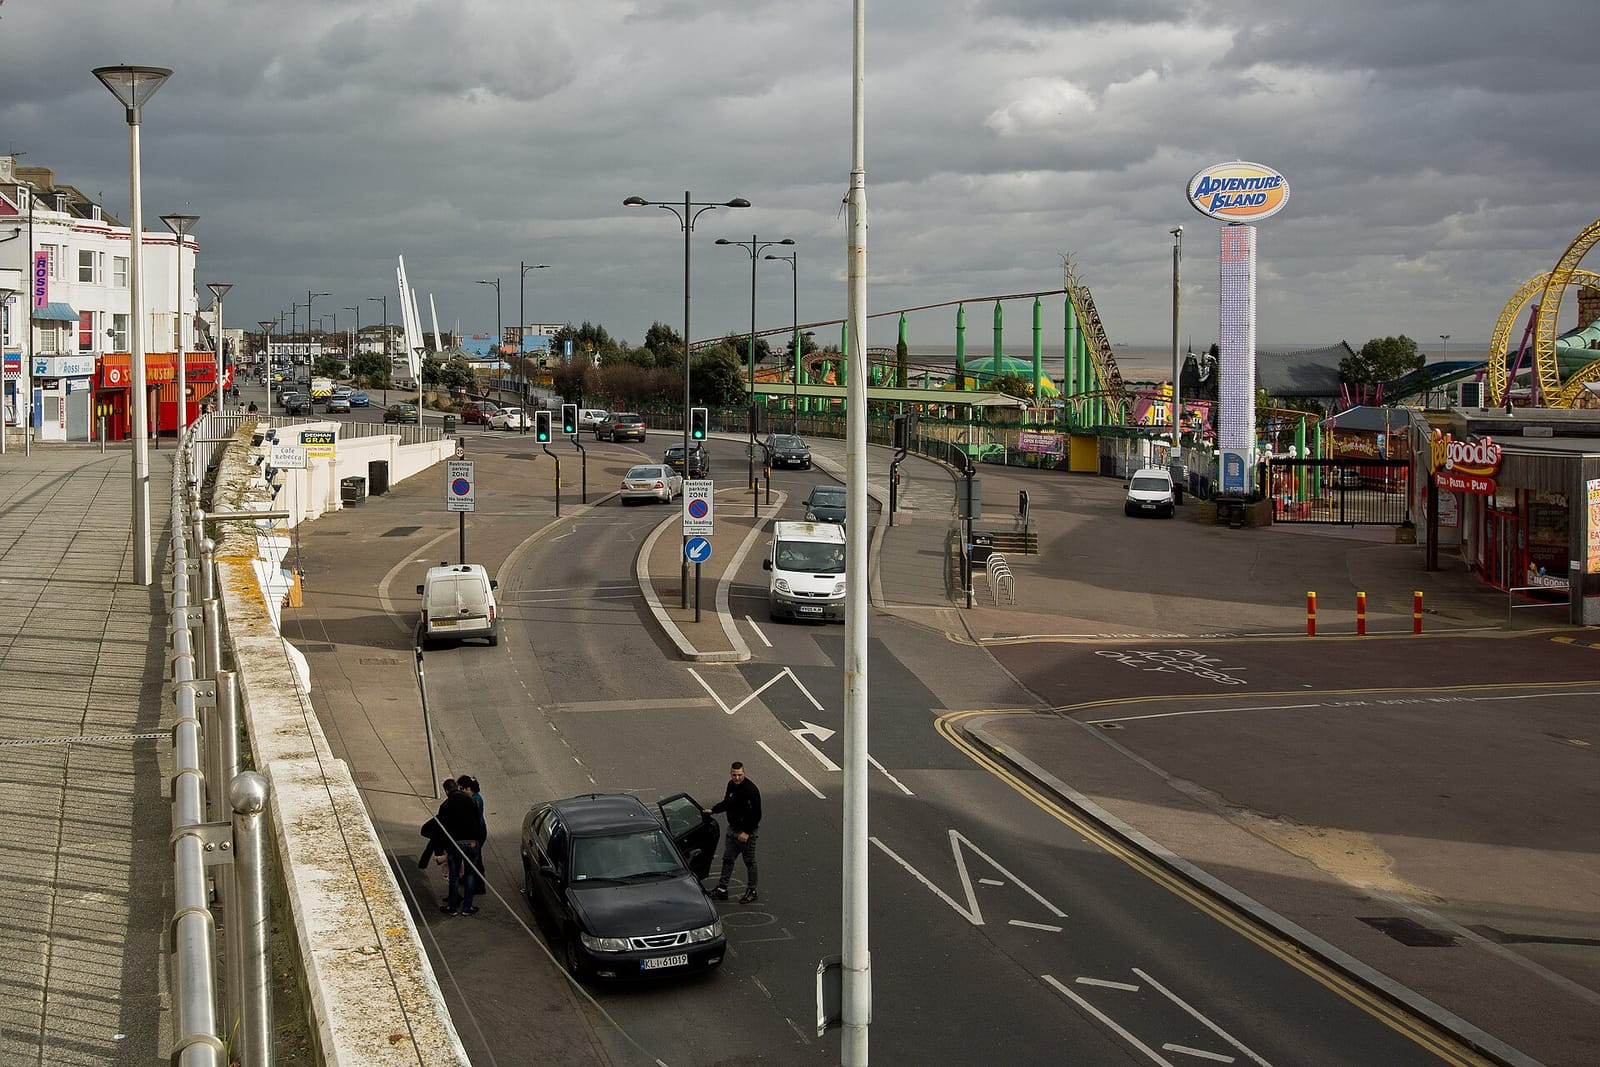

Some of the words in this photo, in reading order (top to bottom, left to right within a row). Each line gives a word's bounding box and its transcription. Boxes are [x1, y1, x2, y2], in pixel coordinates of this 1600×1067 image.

[1193, 176, 1282, 198] ADVENTURE
[1209, 192, 1267, 212] ISLAND
[36, 259, 46, 306] ROSSI
[64, 365, 79, 373] ROSSI
[1449, 478, 1465, 488] PASTA
[1471, 480, 1487, 490] PLAY
